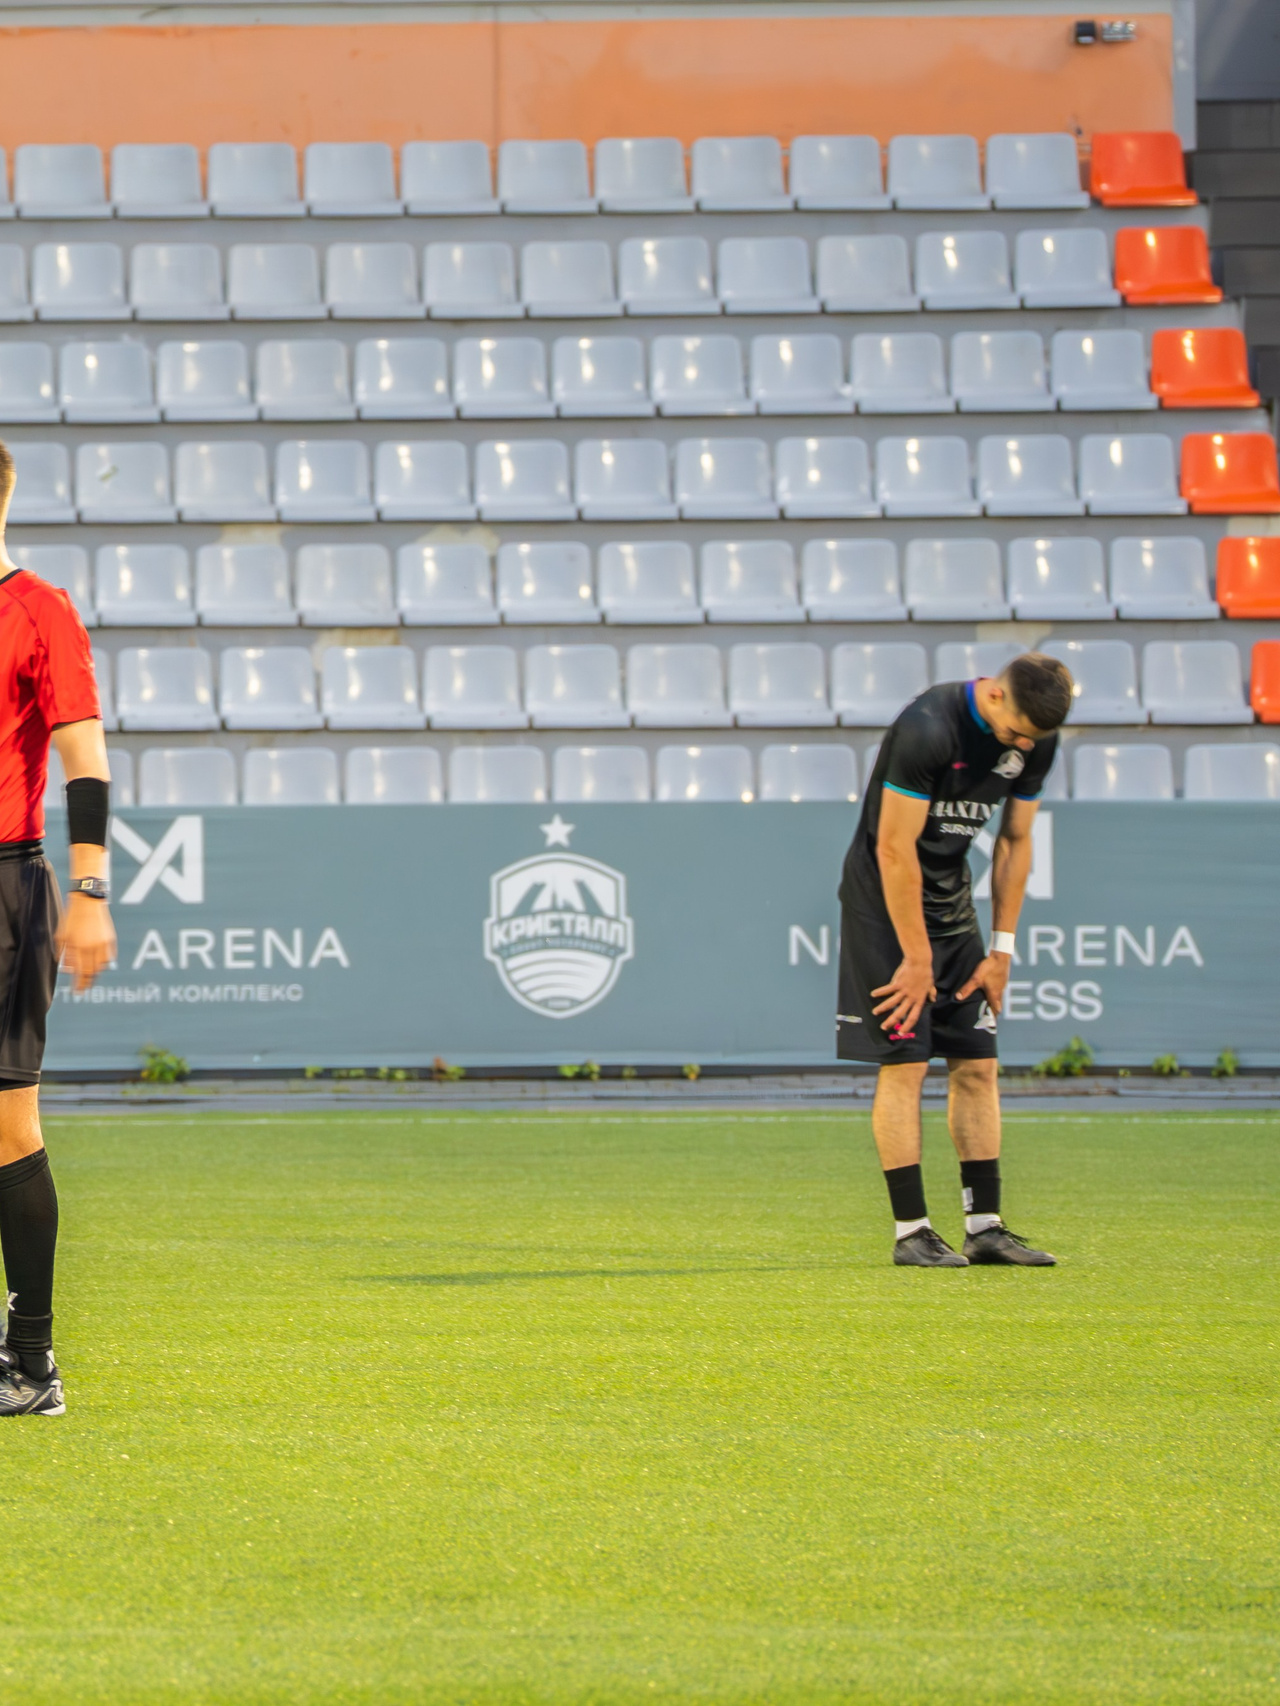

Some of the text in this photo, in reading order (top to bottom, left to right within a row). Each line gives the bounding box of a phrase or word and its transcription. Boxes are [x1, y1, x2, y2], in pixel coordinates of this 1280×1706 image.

[131, 927, 351, 970] ARENA
[492, 911, 626, 949] КРИСТАЛЛ
[1010, 925, 1204, 967] RENA
[59, 982, 303, 1004] ТИВНЫЙ КОМПЛЕКС
